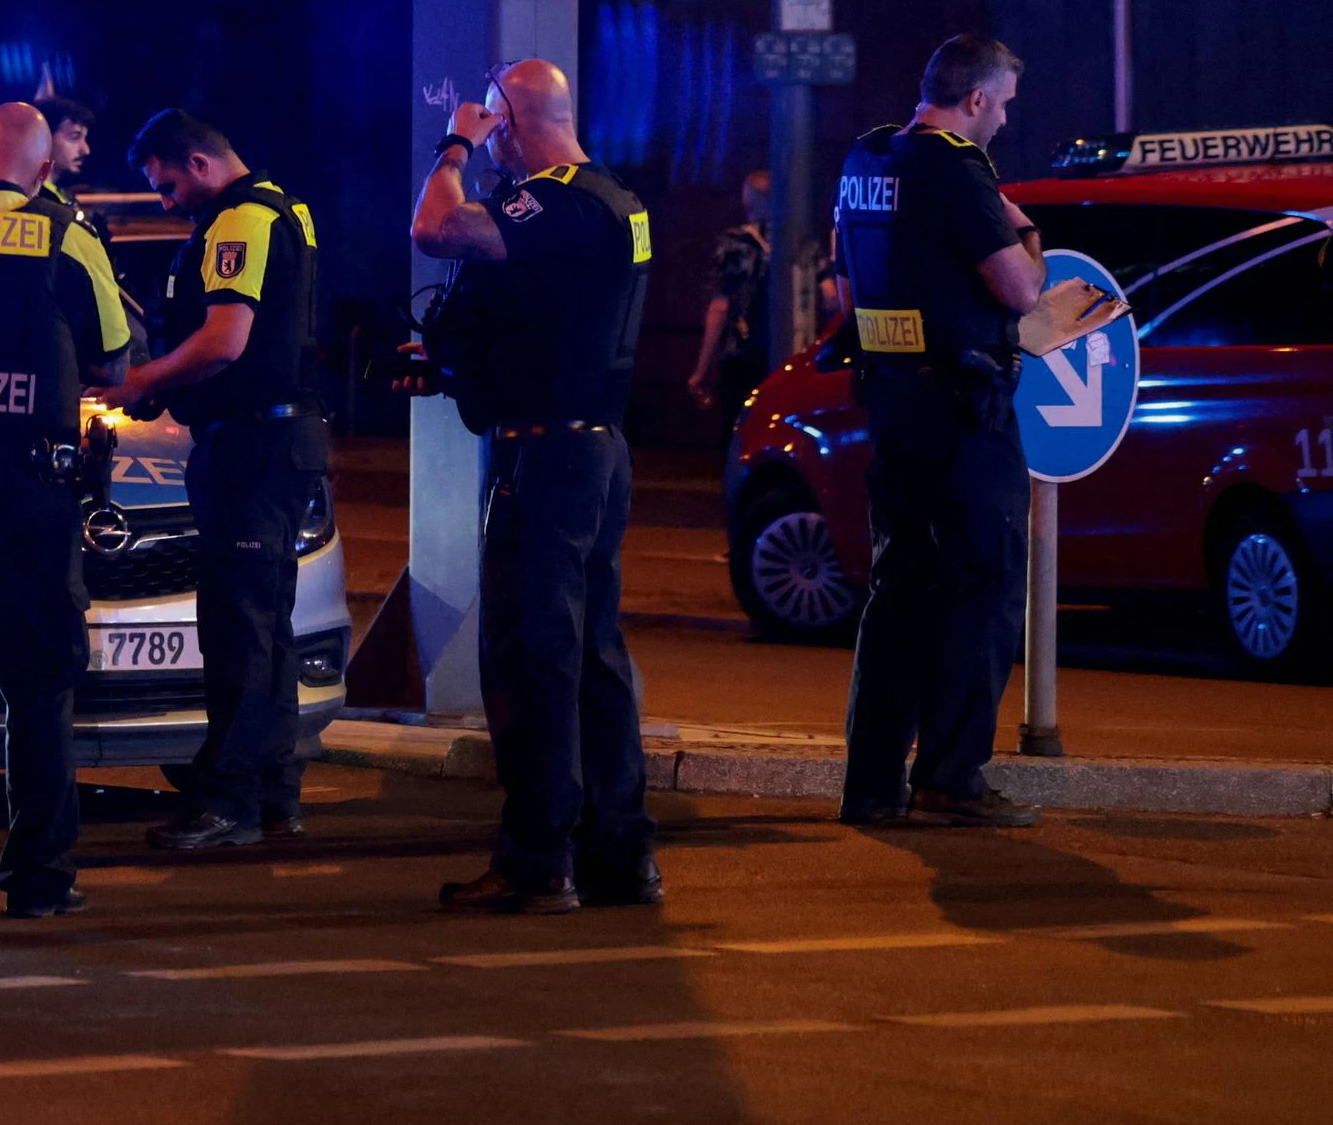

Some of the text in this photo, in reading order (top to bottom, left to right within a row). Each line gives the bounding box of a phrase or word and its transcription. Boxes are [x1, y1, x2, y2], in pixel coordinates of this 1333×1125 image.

[1139, 130, 1333, 163] FEUERWEHR
[839, 176, 900, 212] POLIZEI
[858, 315, 920, 347] POLIZEI
[107, 631, 185, 666] 7789
